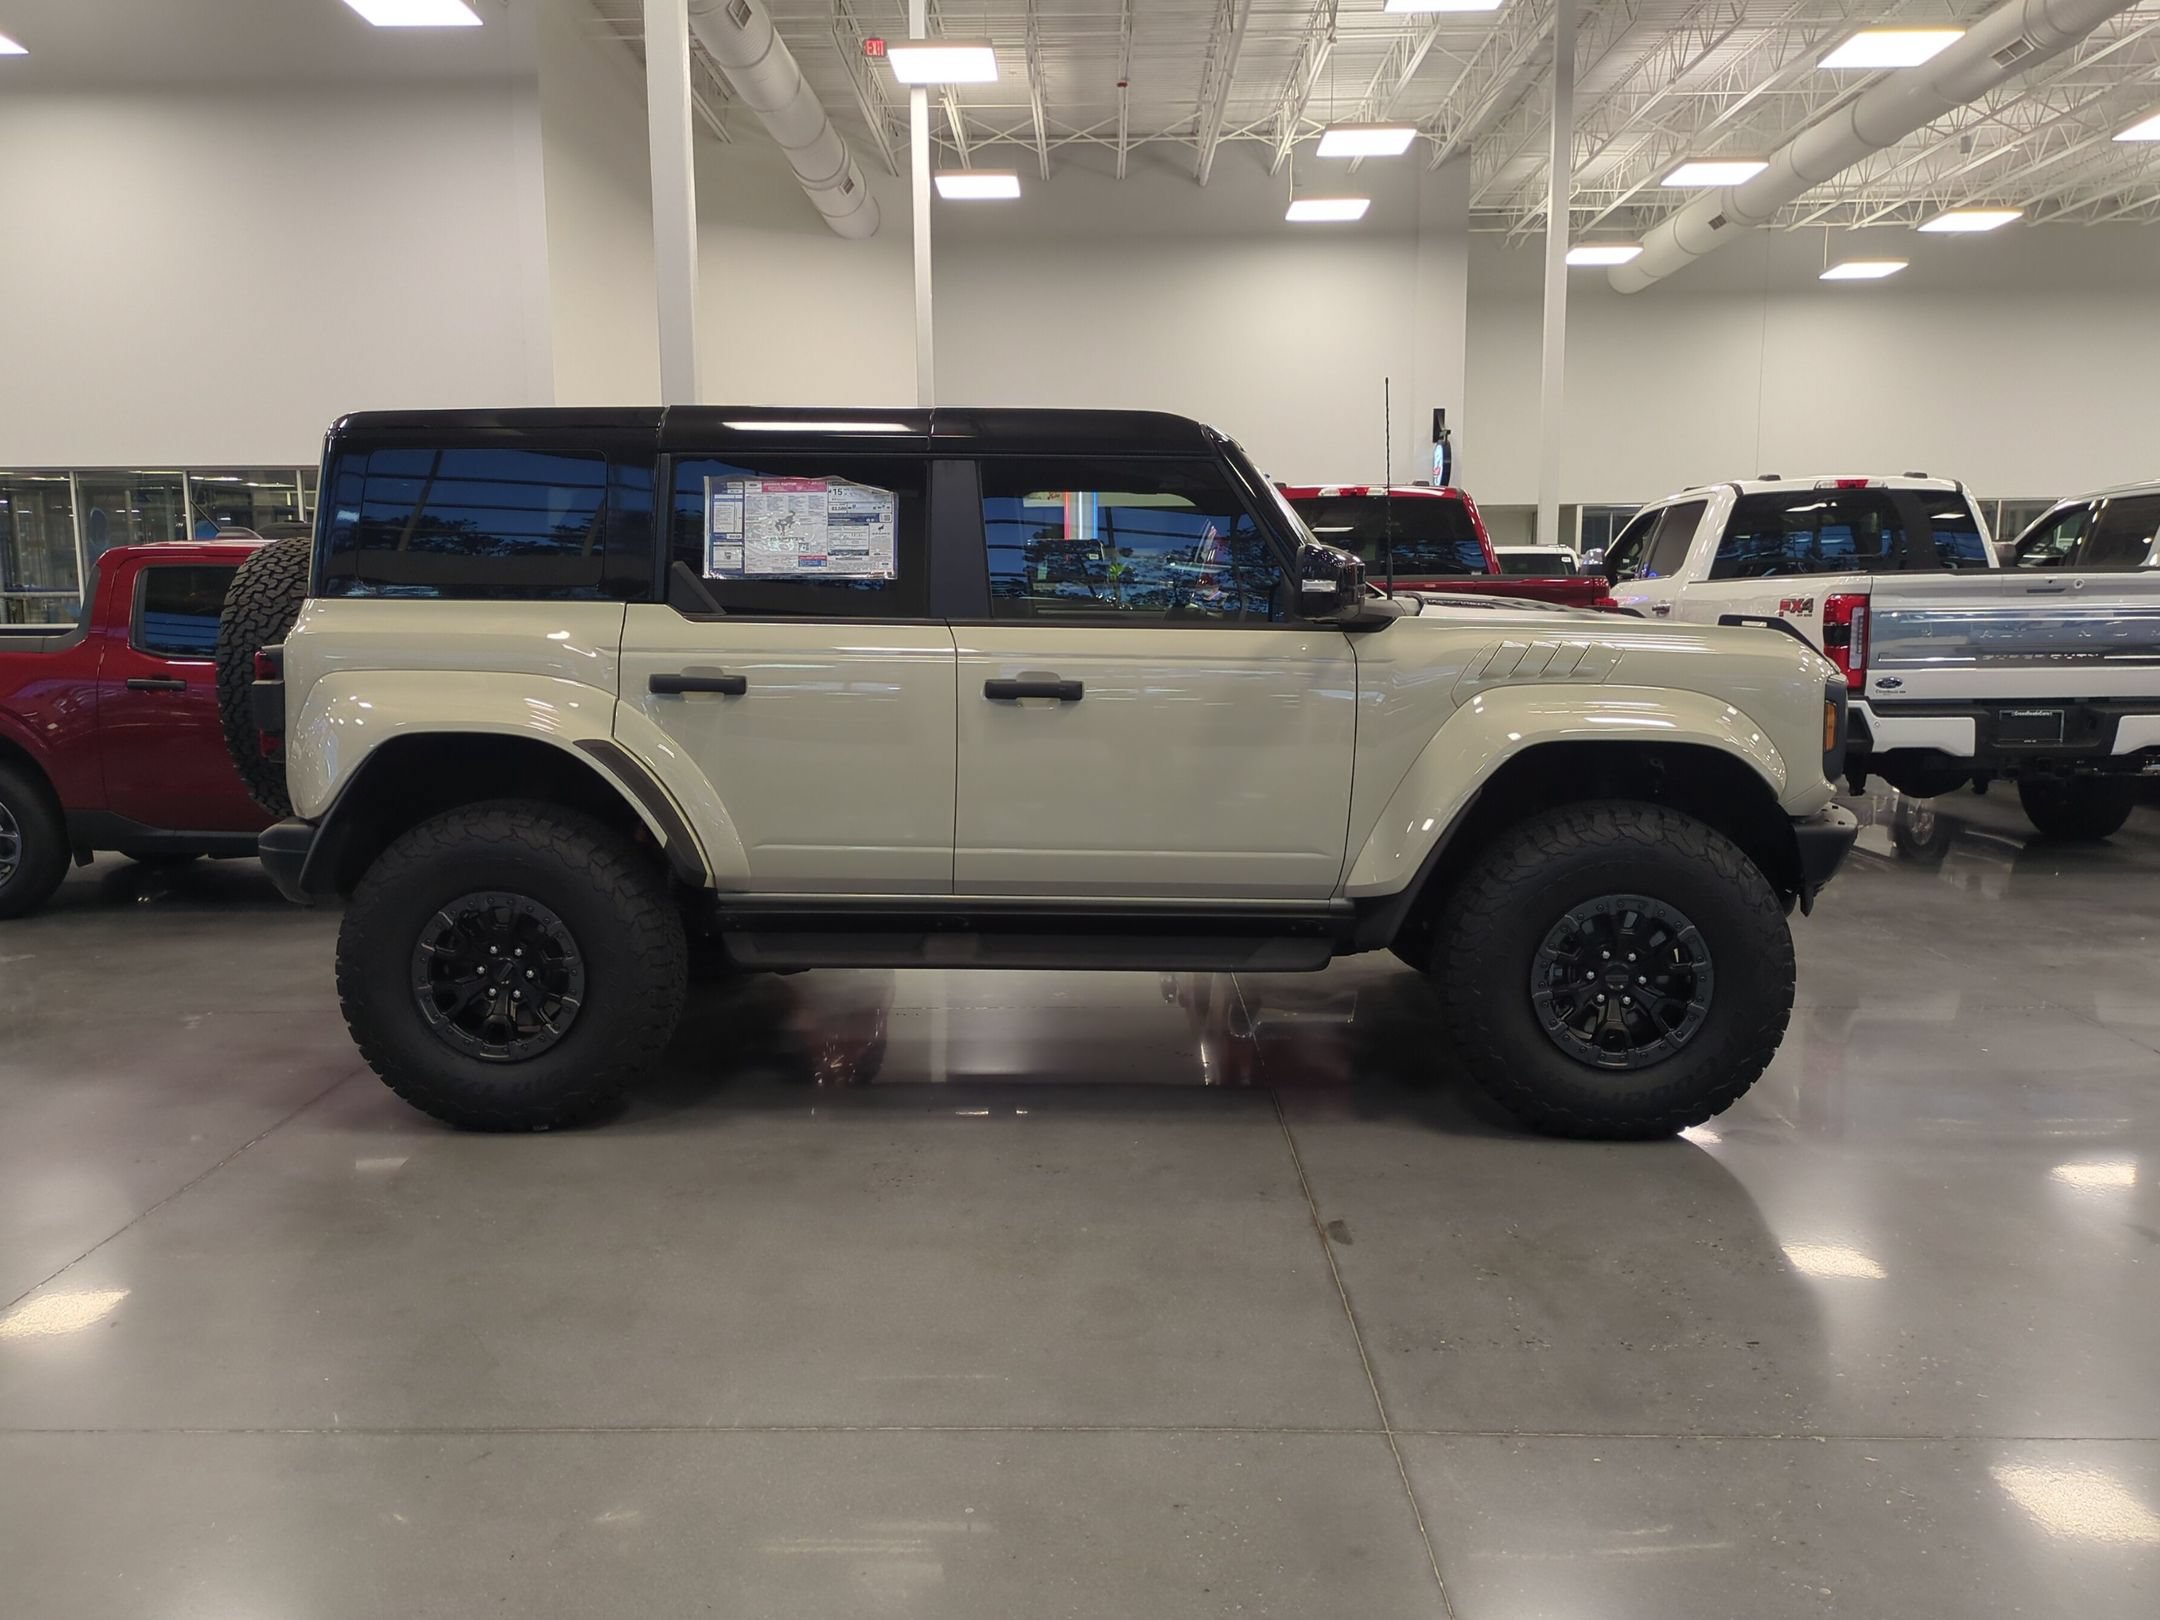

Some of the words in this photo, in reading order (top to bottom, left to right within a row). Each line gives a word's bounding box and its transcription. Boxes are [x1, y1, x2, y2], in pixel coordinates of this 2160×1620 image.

[866, 40, 884, 56] EXIT
[832, 488, 842, 496] 15
[1779, 598, 1814, 617] FX4
